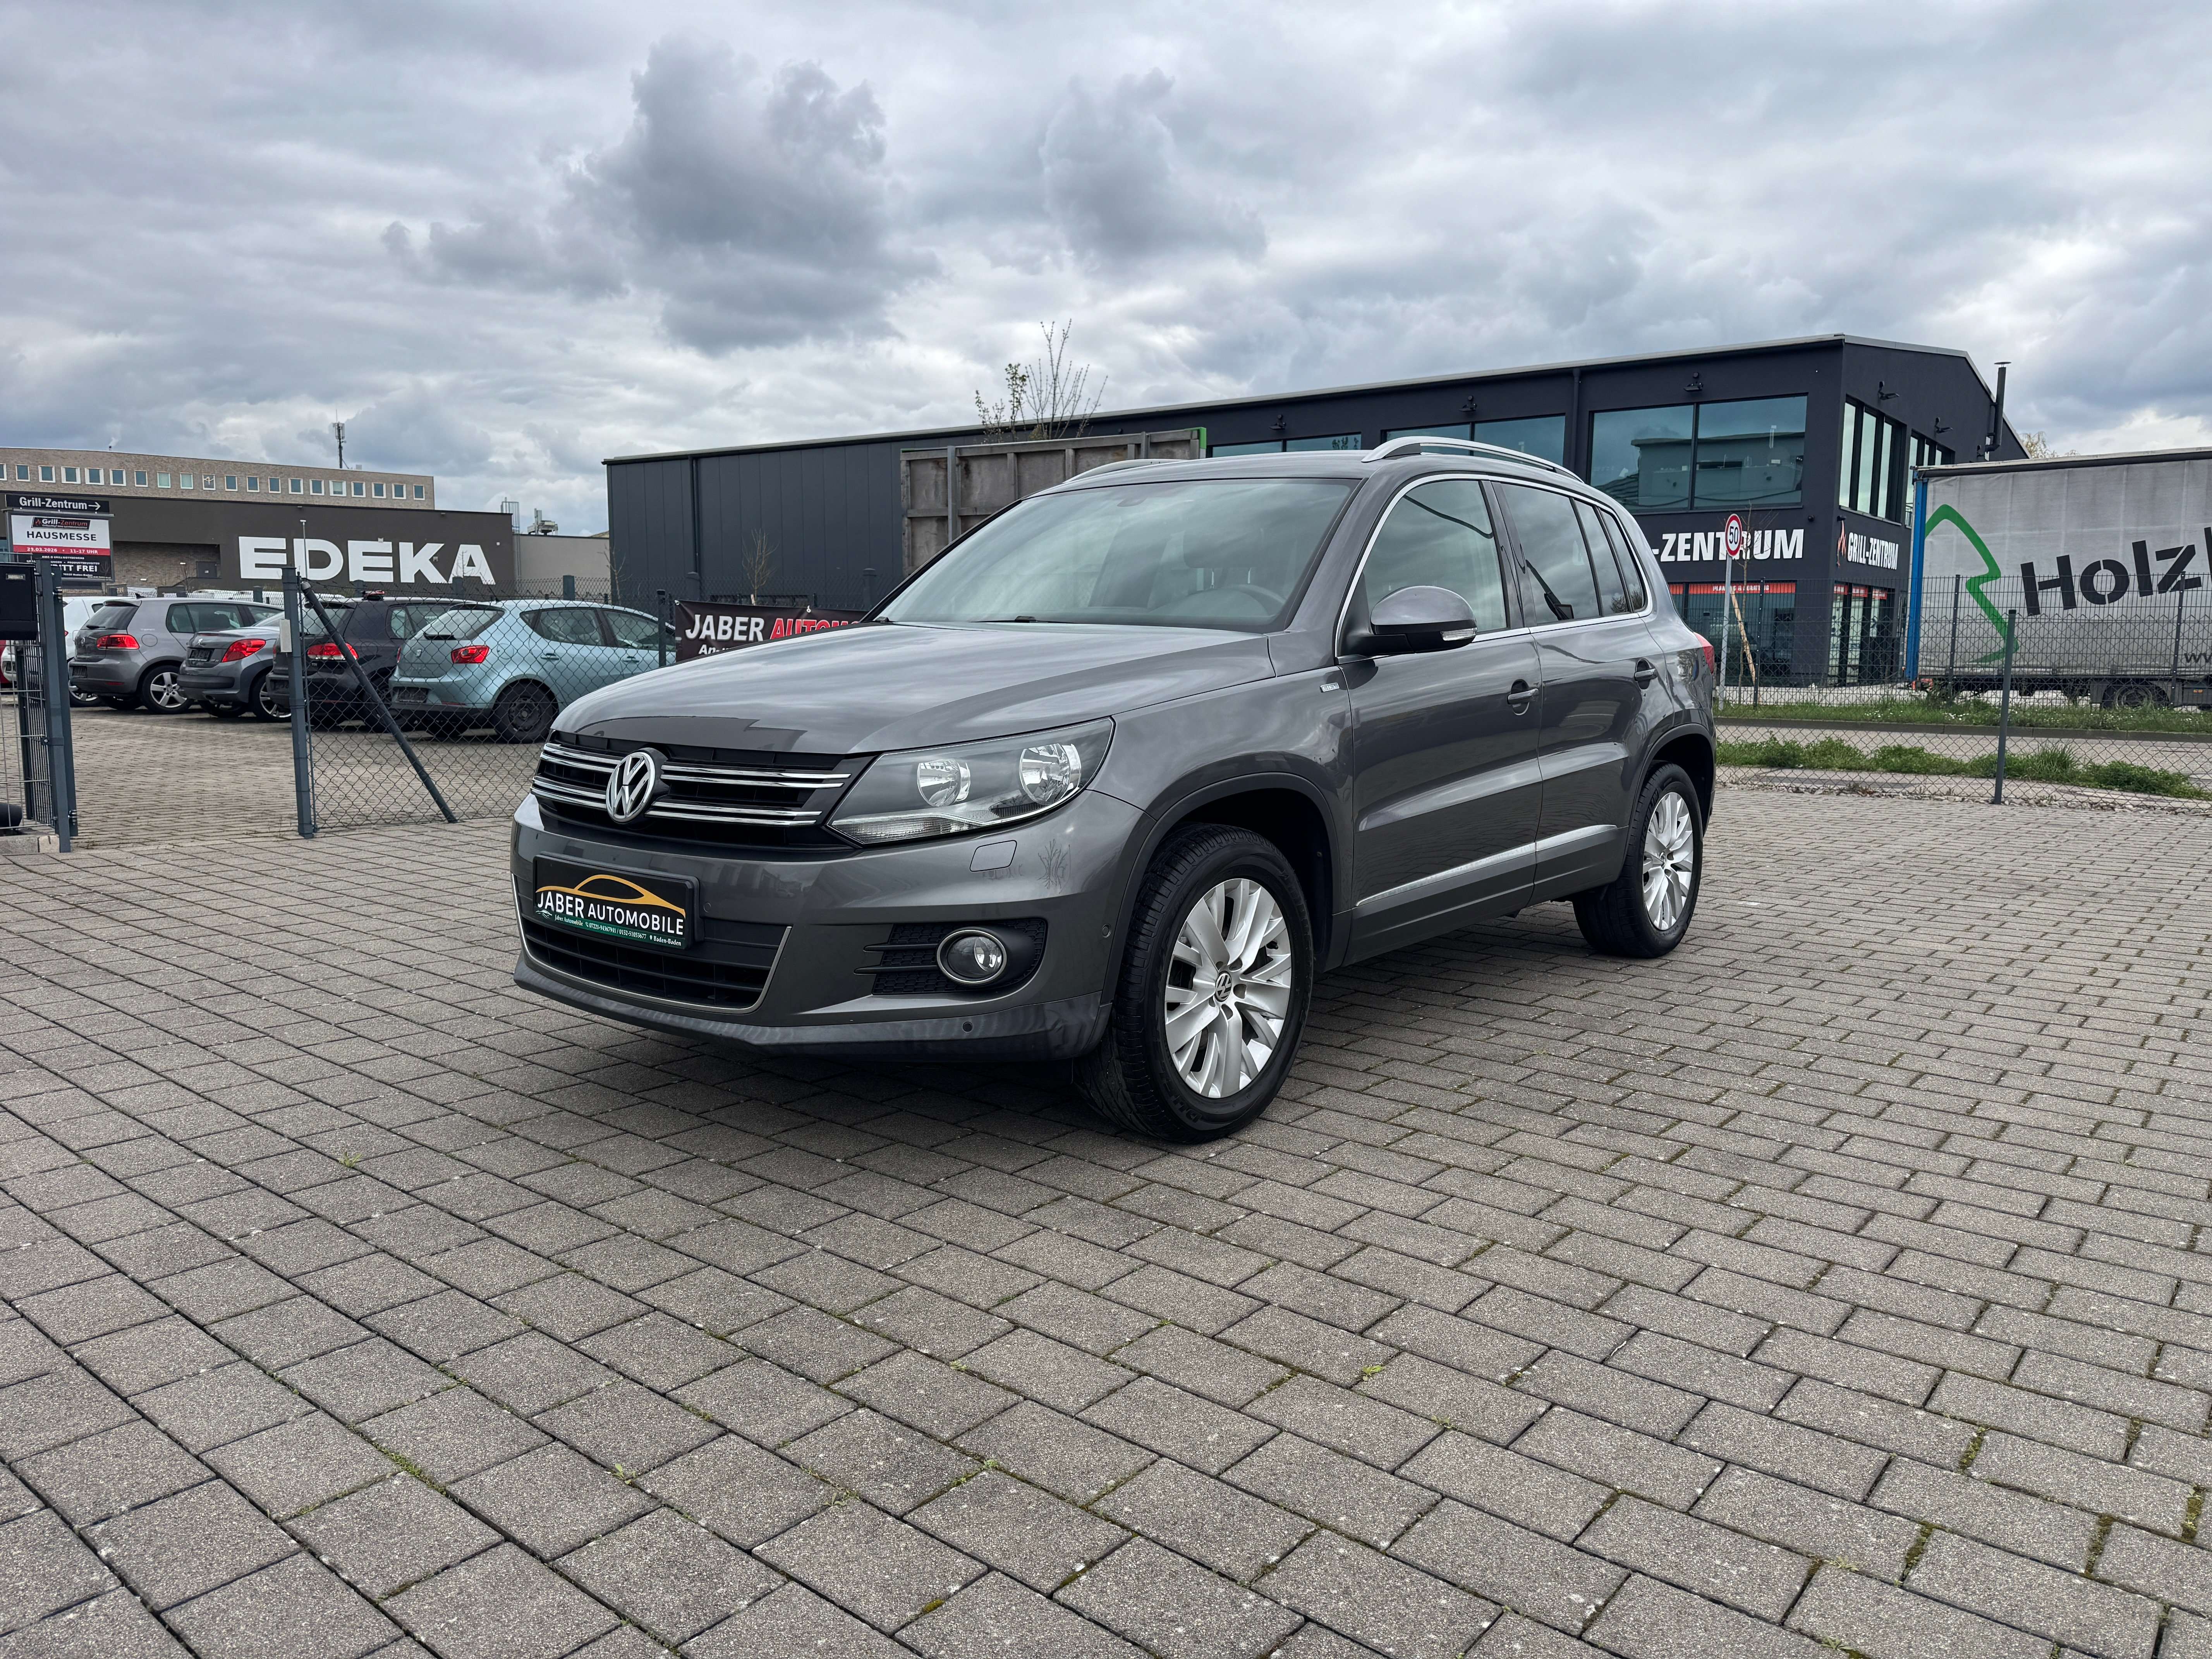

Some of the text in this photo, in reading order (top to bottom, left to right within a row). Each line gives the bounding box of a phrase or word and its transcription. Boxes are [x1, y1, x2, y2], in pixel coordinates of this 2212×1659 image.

[19, 496, 87, 510] Grill-Zentrum
[27, 531, 97, 541] HAUSMESSE
[1729, 526, 1738, 544] 50
[239, 536, 496, 585] EDEKA
[1847, 532, 1899, 570] GRILL-ZENTRUM
[685, 614, 765, 642] JABER
[538, 891, 684, 935] JABER AUTOMOBILE
[654, 936, 682, 946] Baden-Baden
